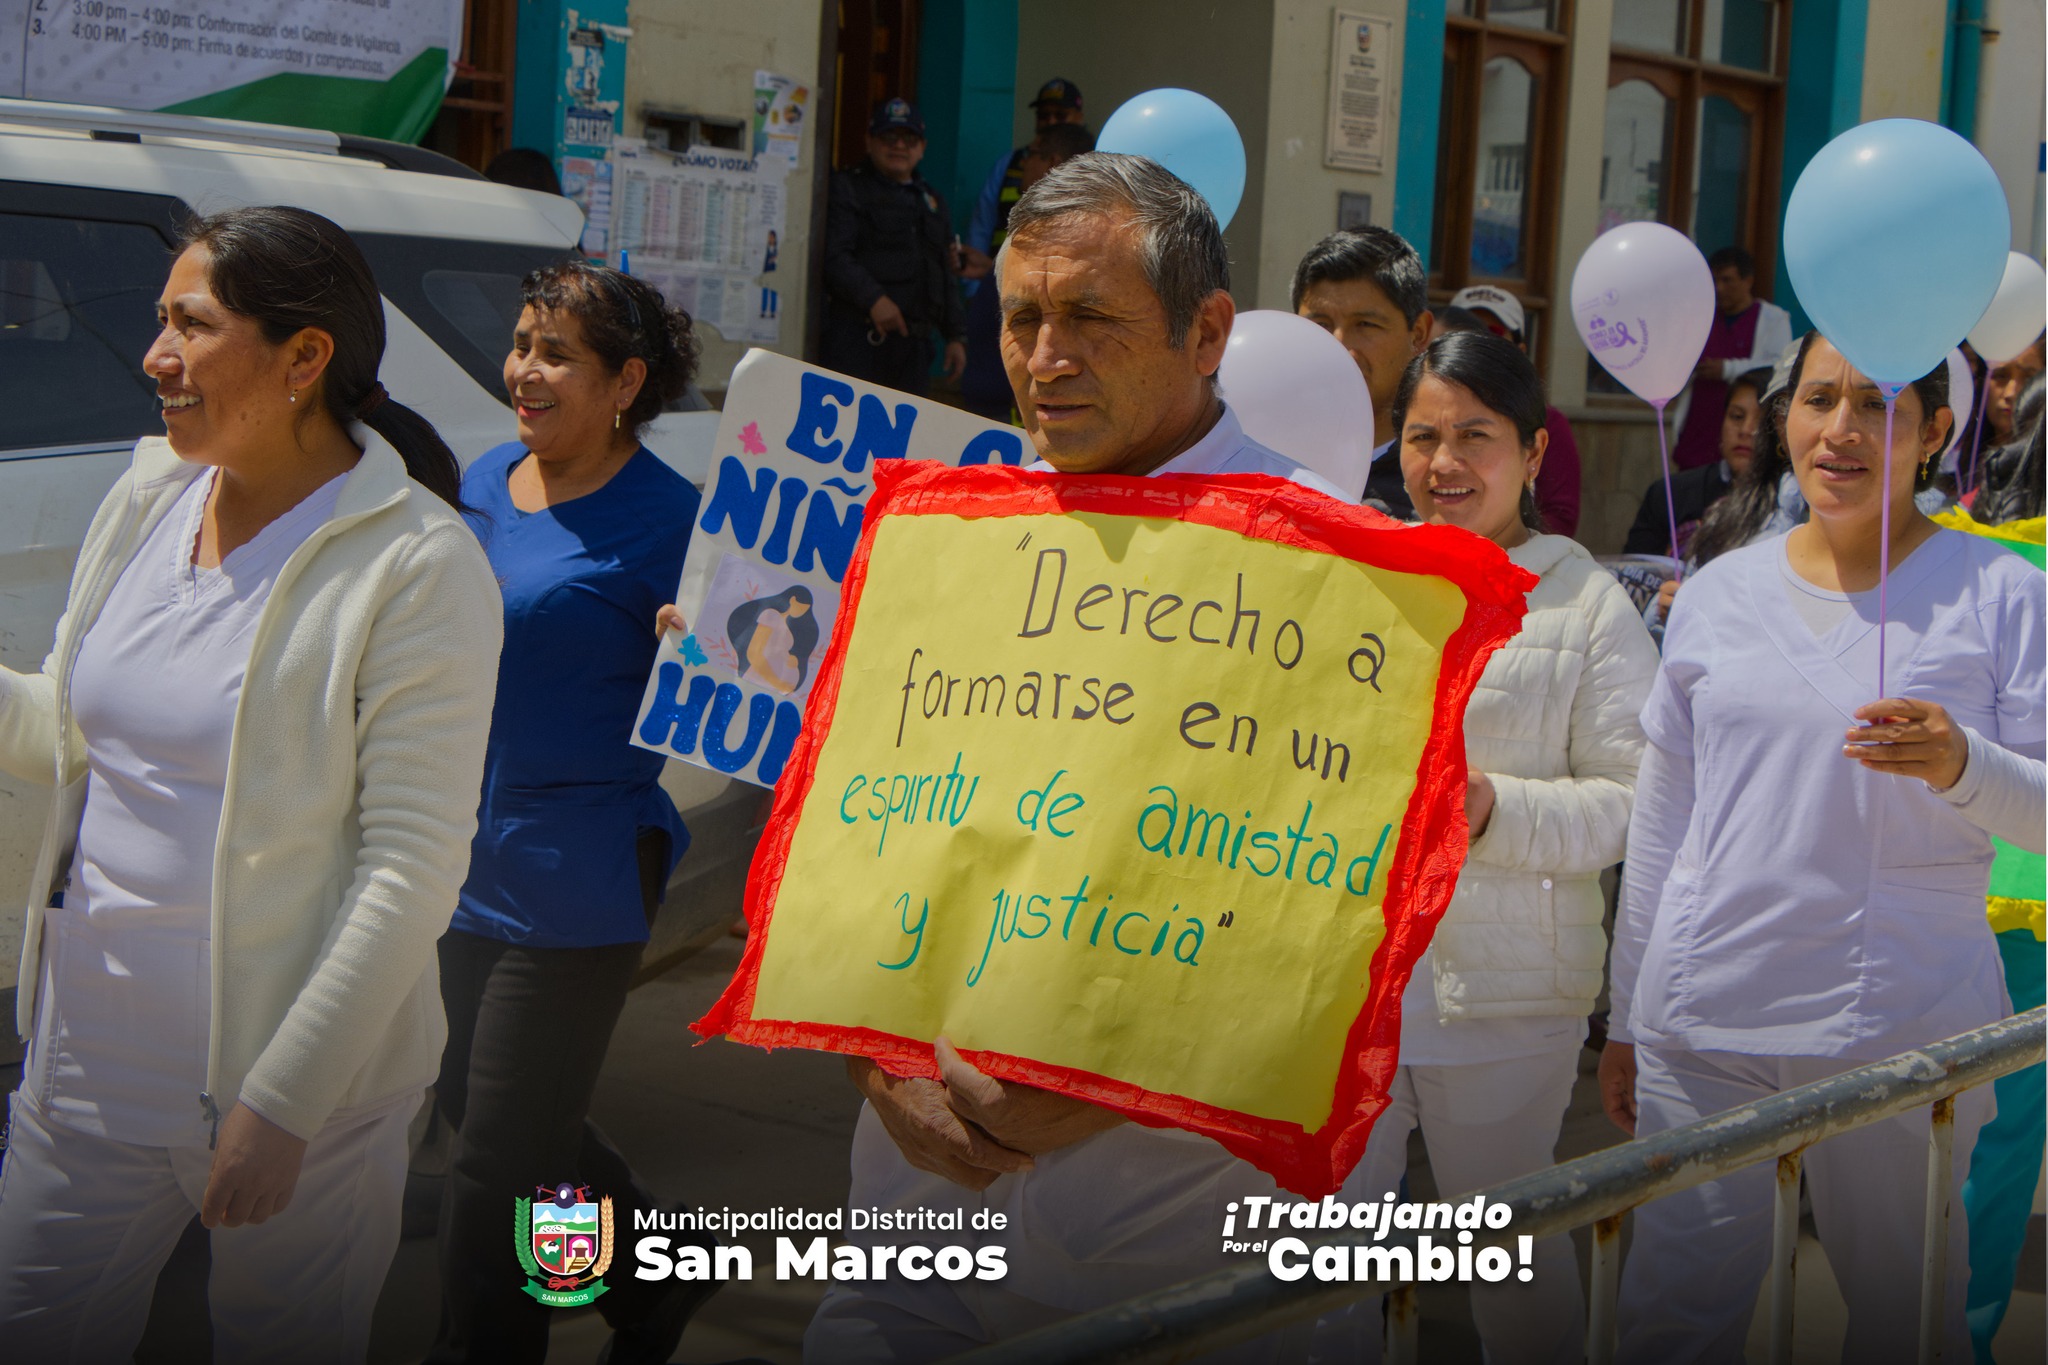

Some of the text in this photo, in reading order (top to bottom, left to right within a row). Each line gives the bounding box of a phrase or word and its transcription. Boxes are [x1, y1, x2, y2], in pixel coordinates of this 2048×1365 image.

[33, 18, 46, 35] 3.
[72, 23, 101, 41] 4:00
[105, 28, 127, 43] PM
[142, 31, 170, 48] 5:00
[198, 37, 232, 56] Firma
[236, 42, 249, 57] de
[250, 46, 304, 63] acuerdos
[306, 53, 314, 67] y
[73, 0, 102, 18] 3:00
[106, 7, 127, 21] pm
[142, 8, 170, 26] 4:00
[281, 24, 299, 39] del
[341, 33, 353, 47] de
[786, 371, 918, 473] EN
[1347, 633, 1386, 693] a
[896, 648, 1351, 783] formarse en un
[1017, 770, 1085, 838] de
[1137, 785, 1392, 897] amistad
[877, 892, 929, 970] y
